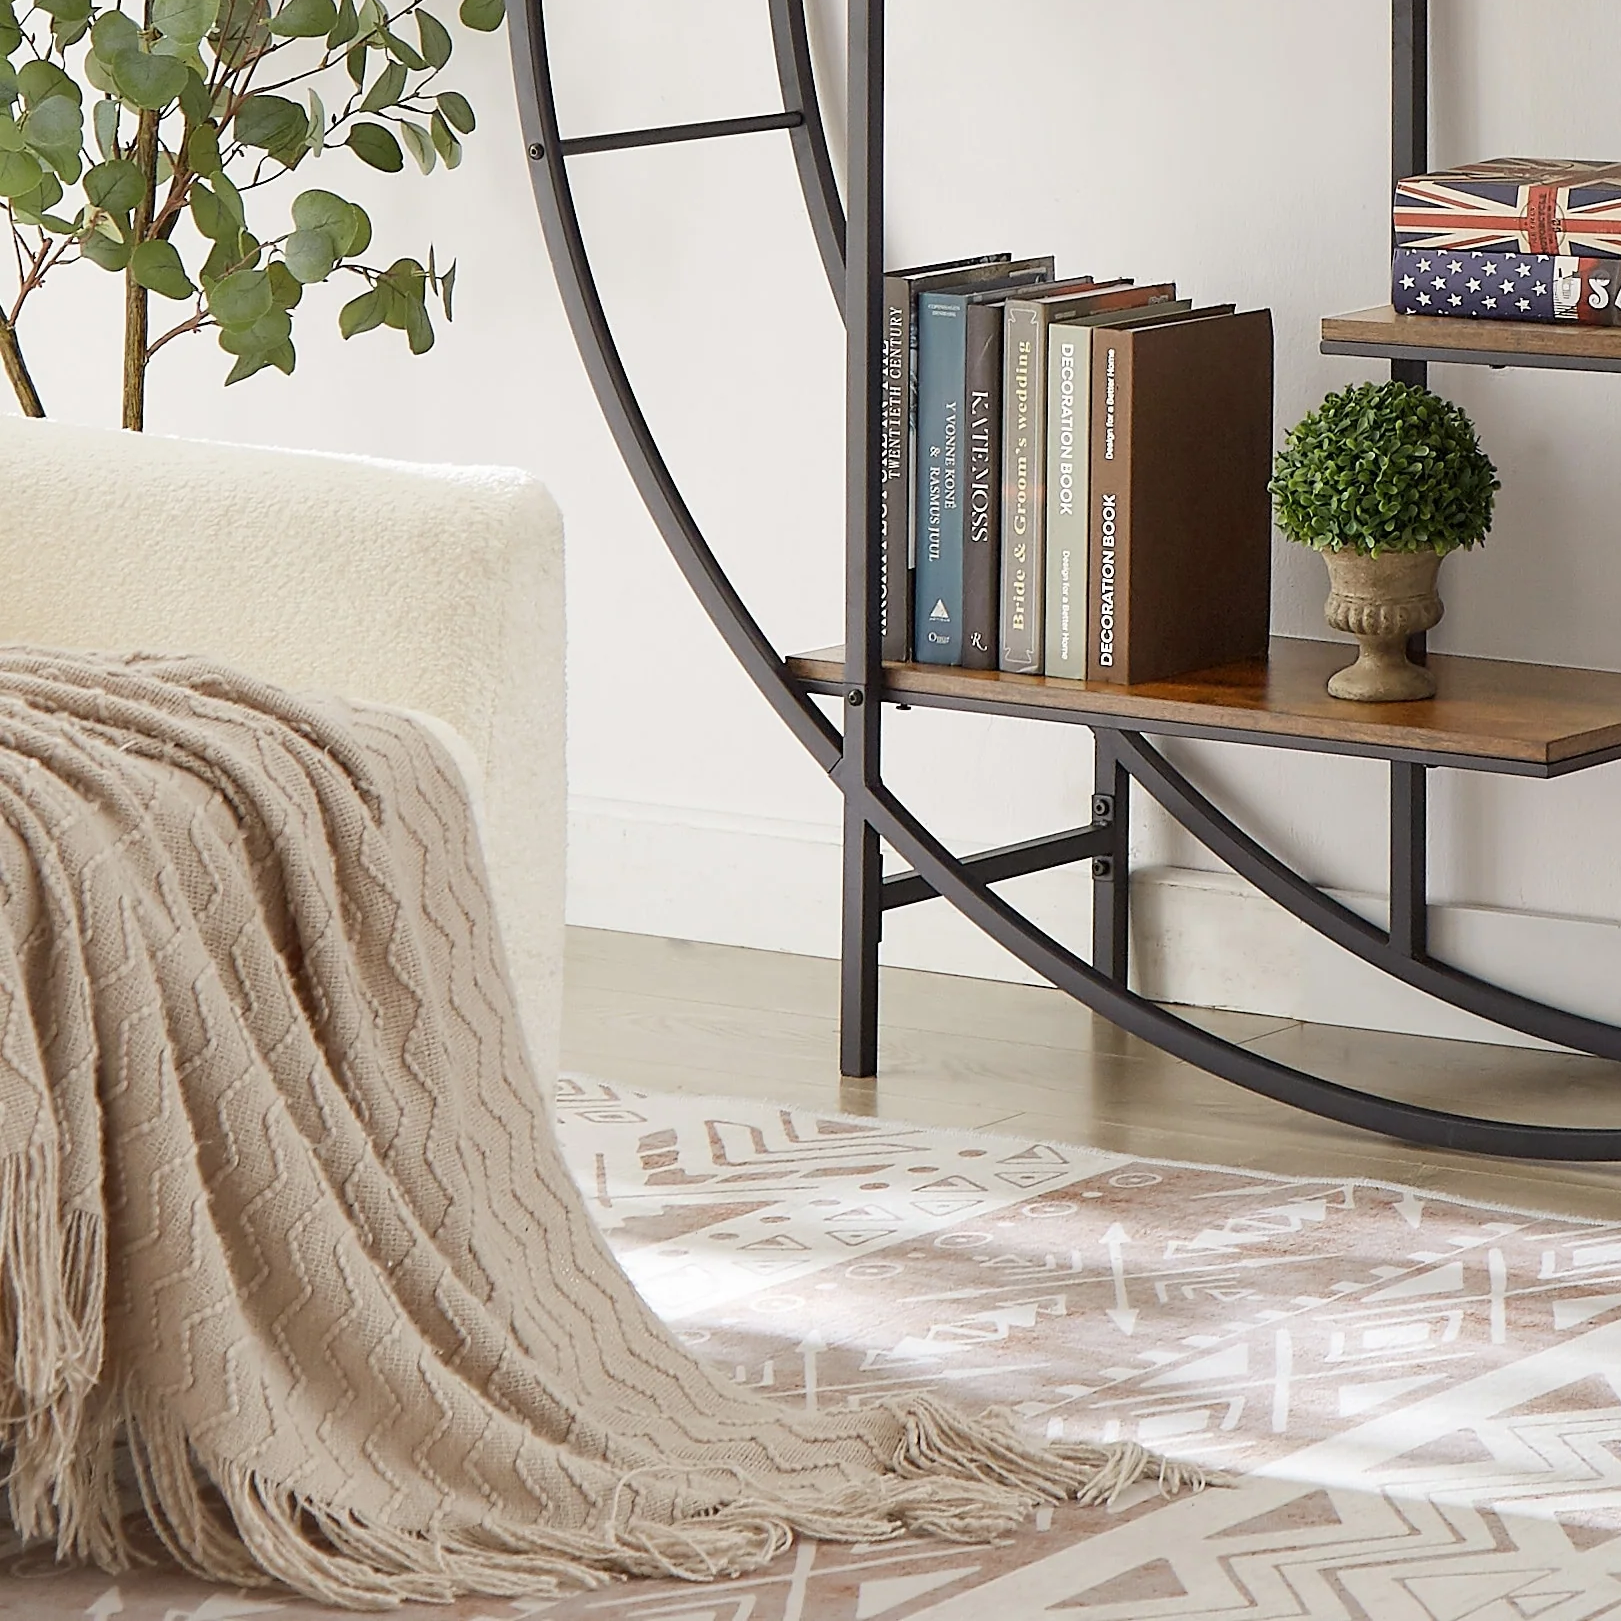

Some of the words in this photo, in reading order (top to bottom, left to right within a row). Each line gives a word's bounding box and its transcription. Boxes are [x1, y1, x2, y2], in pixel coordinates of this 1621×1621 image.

[889, 306, 903, 380] CENTURY
[1106, 348, 1115, 377] Home
[1016, 339, 1032, 430] wedding
[1060, 343, 1074, 459] DECORATION
[1105, 377, 1115, 406] Better
[887, 385, 901, 479] TWENTIETH
[1105, 413, 1114, 428] for
[929, 446, 941, 458] &
[1105, 428, 1115, 460] Design
[929, 466, 941, 524] RASMUS
[1013, 436, 1028, 534] Groom's
[1059, 461, 1074, 516] BOOK
[1102, 494, 1116, 548] BOOK
[928, 527, 940, 562] JUUL
[1013, 543, 1027, 562] &
[1061, 550, 1070, 582] Design
[1012, 568, 1027, 631] Bride
[1062, 582, 1070, 595] for
[1062, 604, 1070, 631] Better
[1099, 550, 1116, 667] DECORATION
[1061, 632, 1070, 660] Home
